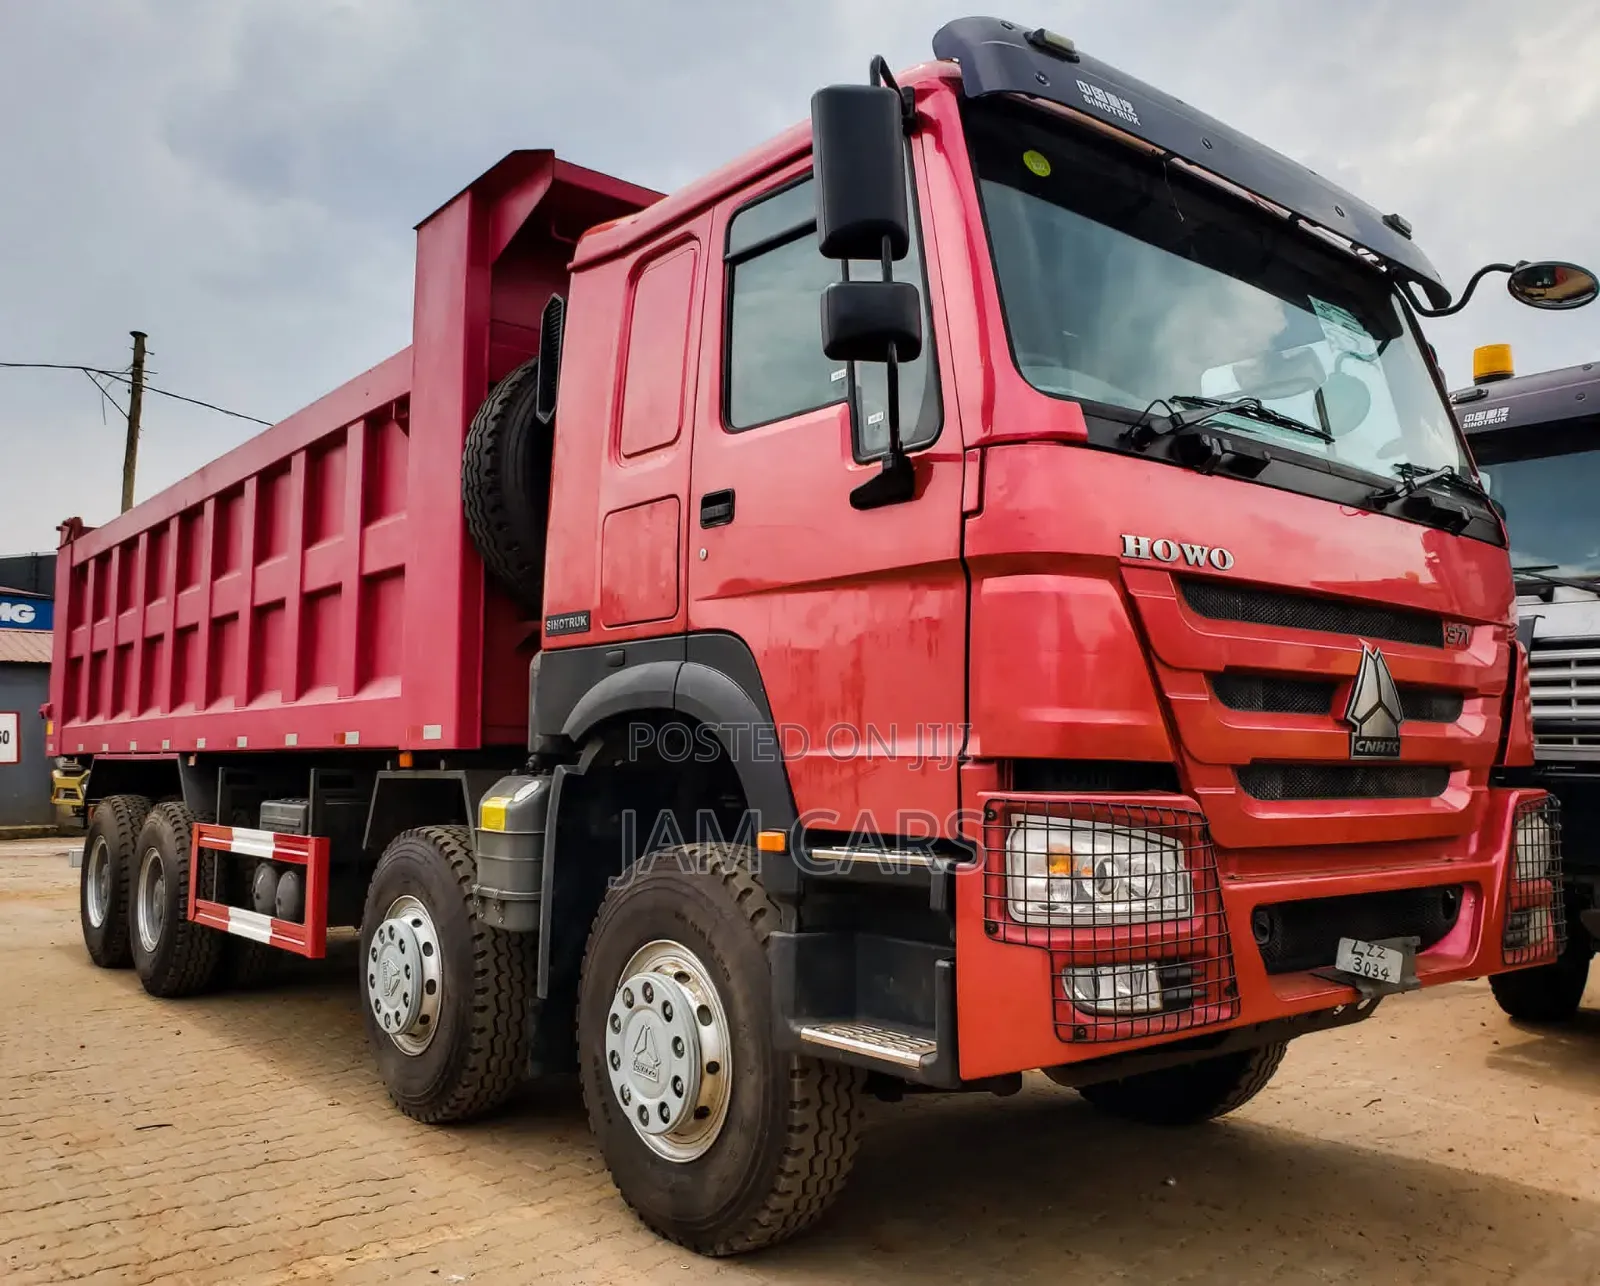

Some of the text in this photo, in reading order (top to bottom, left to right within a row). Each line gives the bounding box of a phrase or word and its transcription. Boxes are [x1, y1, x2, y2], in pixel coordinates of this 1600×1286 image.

[1082, 94, 1141, 126] SINOTRUK
[1462, 416, 1507, 429] SINOTRUK
[1120, 534, 1235, 571] HOWO
[546, 615, 587, 631] SINOTRUK
[1355, 740, 1400, 753] CNHTC
[1352, 957, 1390, 980] 3034
